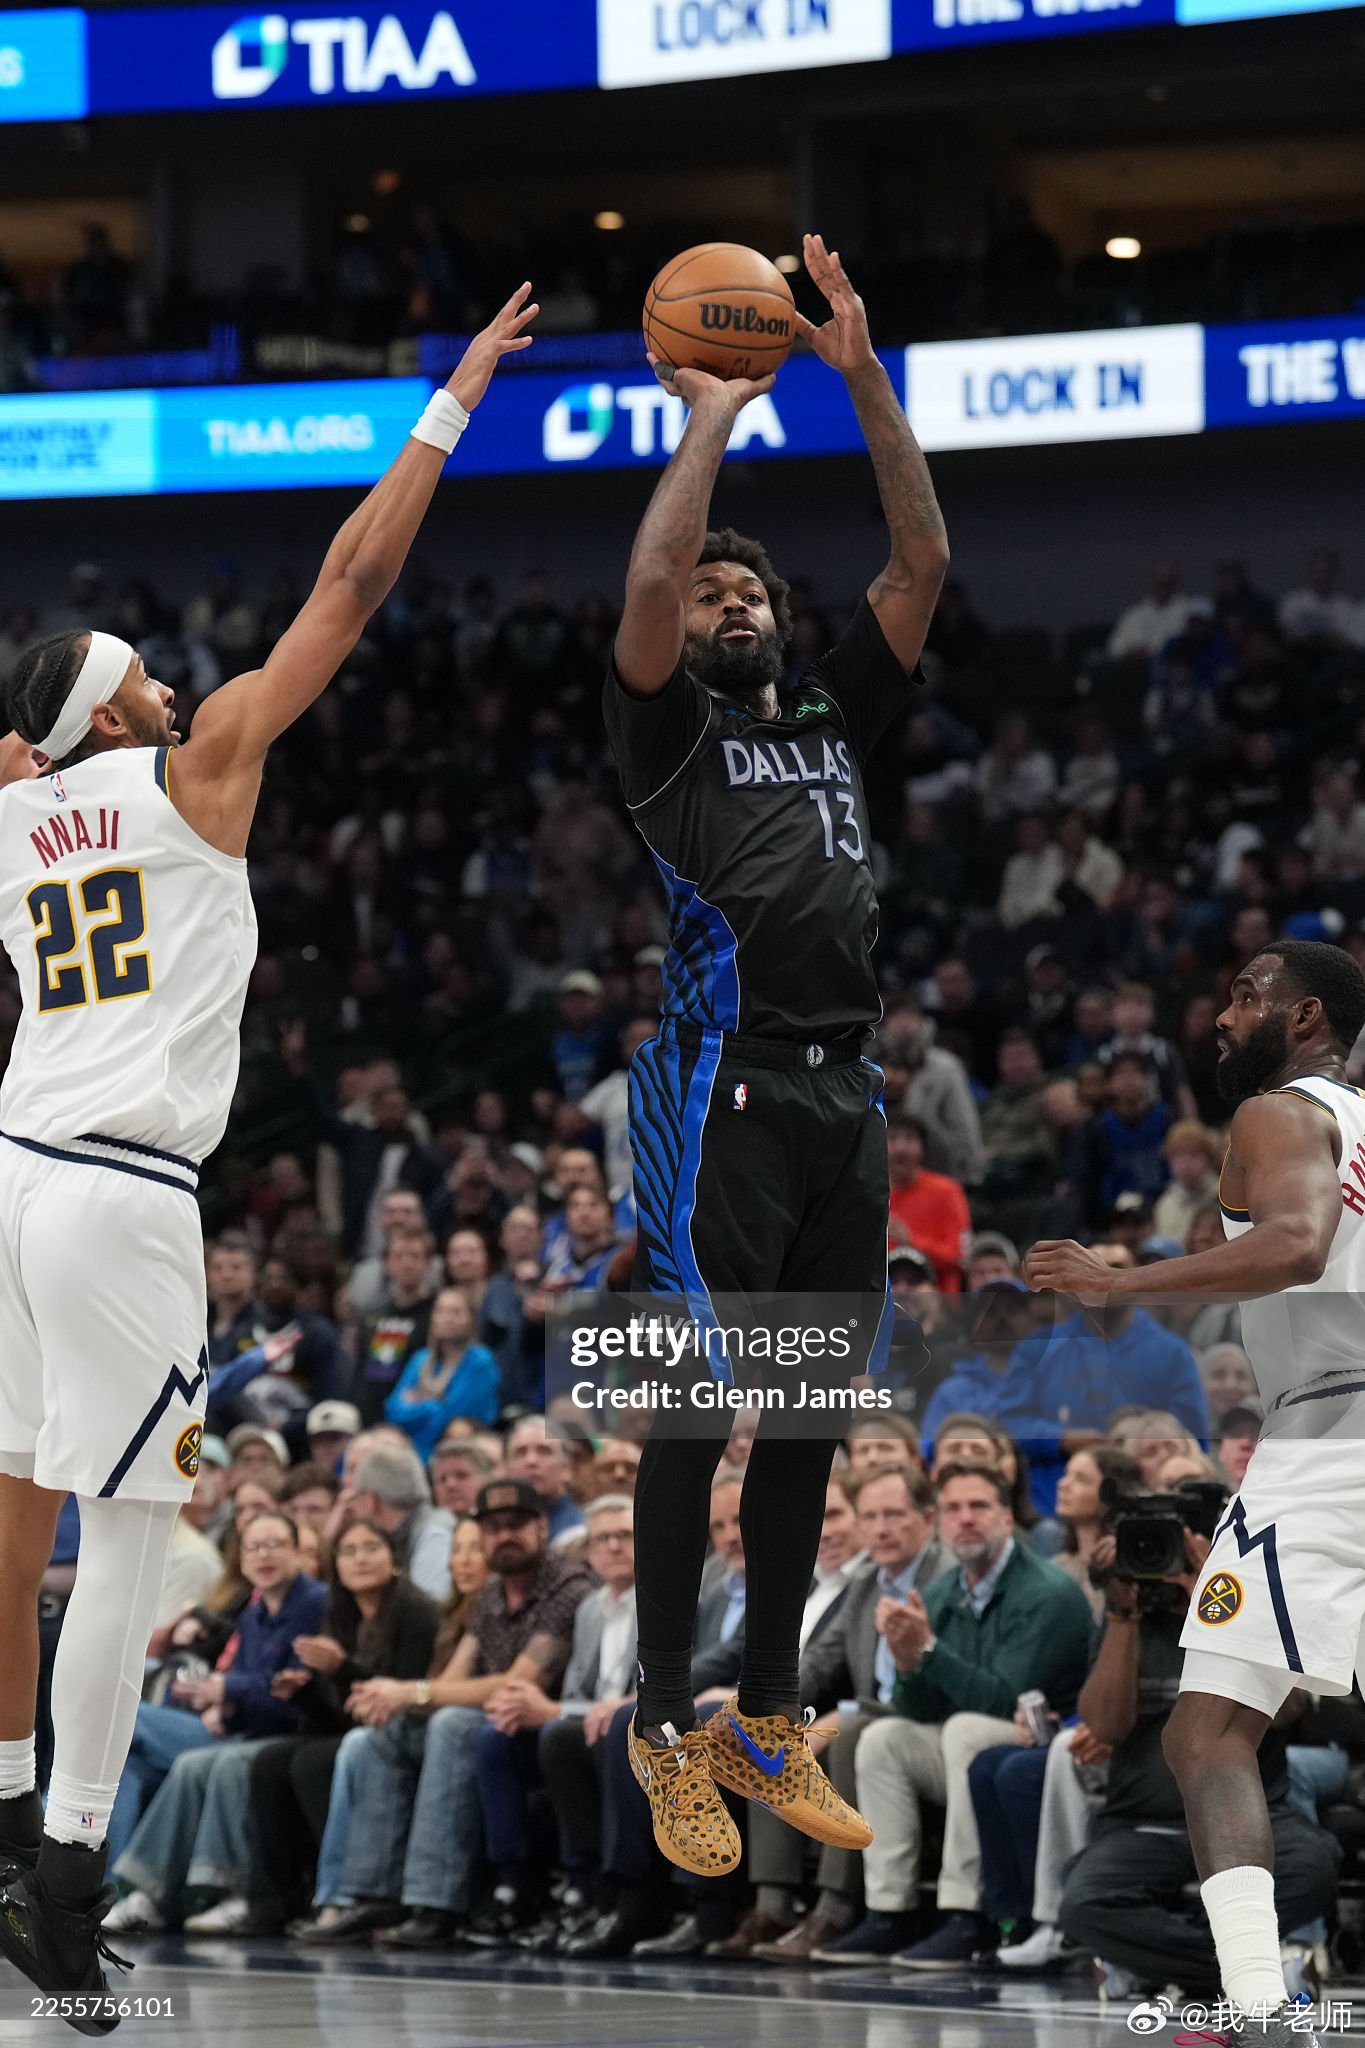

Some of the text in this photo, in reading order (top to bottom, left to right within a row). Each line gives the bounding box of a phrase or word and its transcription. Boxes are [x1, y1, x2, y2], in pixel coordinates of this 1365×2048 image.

[291, 11, 476, 94] TIAA
[655, 0, 764, 49] LOCK
[700, 303, 789, 336] Wilson
[964, 361, 1145, 418] LOCK IN
[1239, 339, 1339, 407] THE
[615, 383, 787, 456] TIA
[719, 735, 852, 787] DALLAS
[29, 808, 119, 869] NNAJI
[808, 787, 864, 862] 13
[25, 866, 153, 1015] 22
